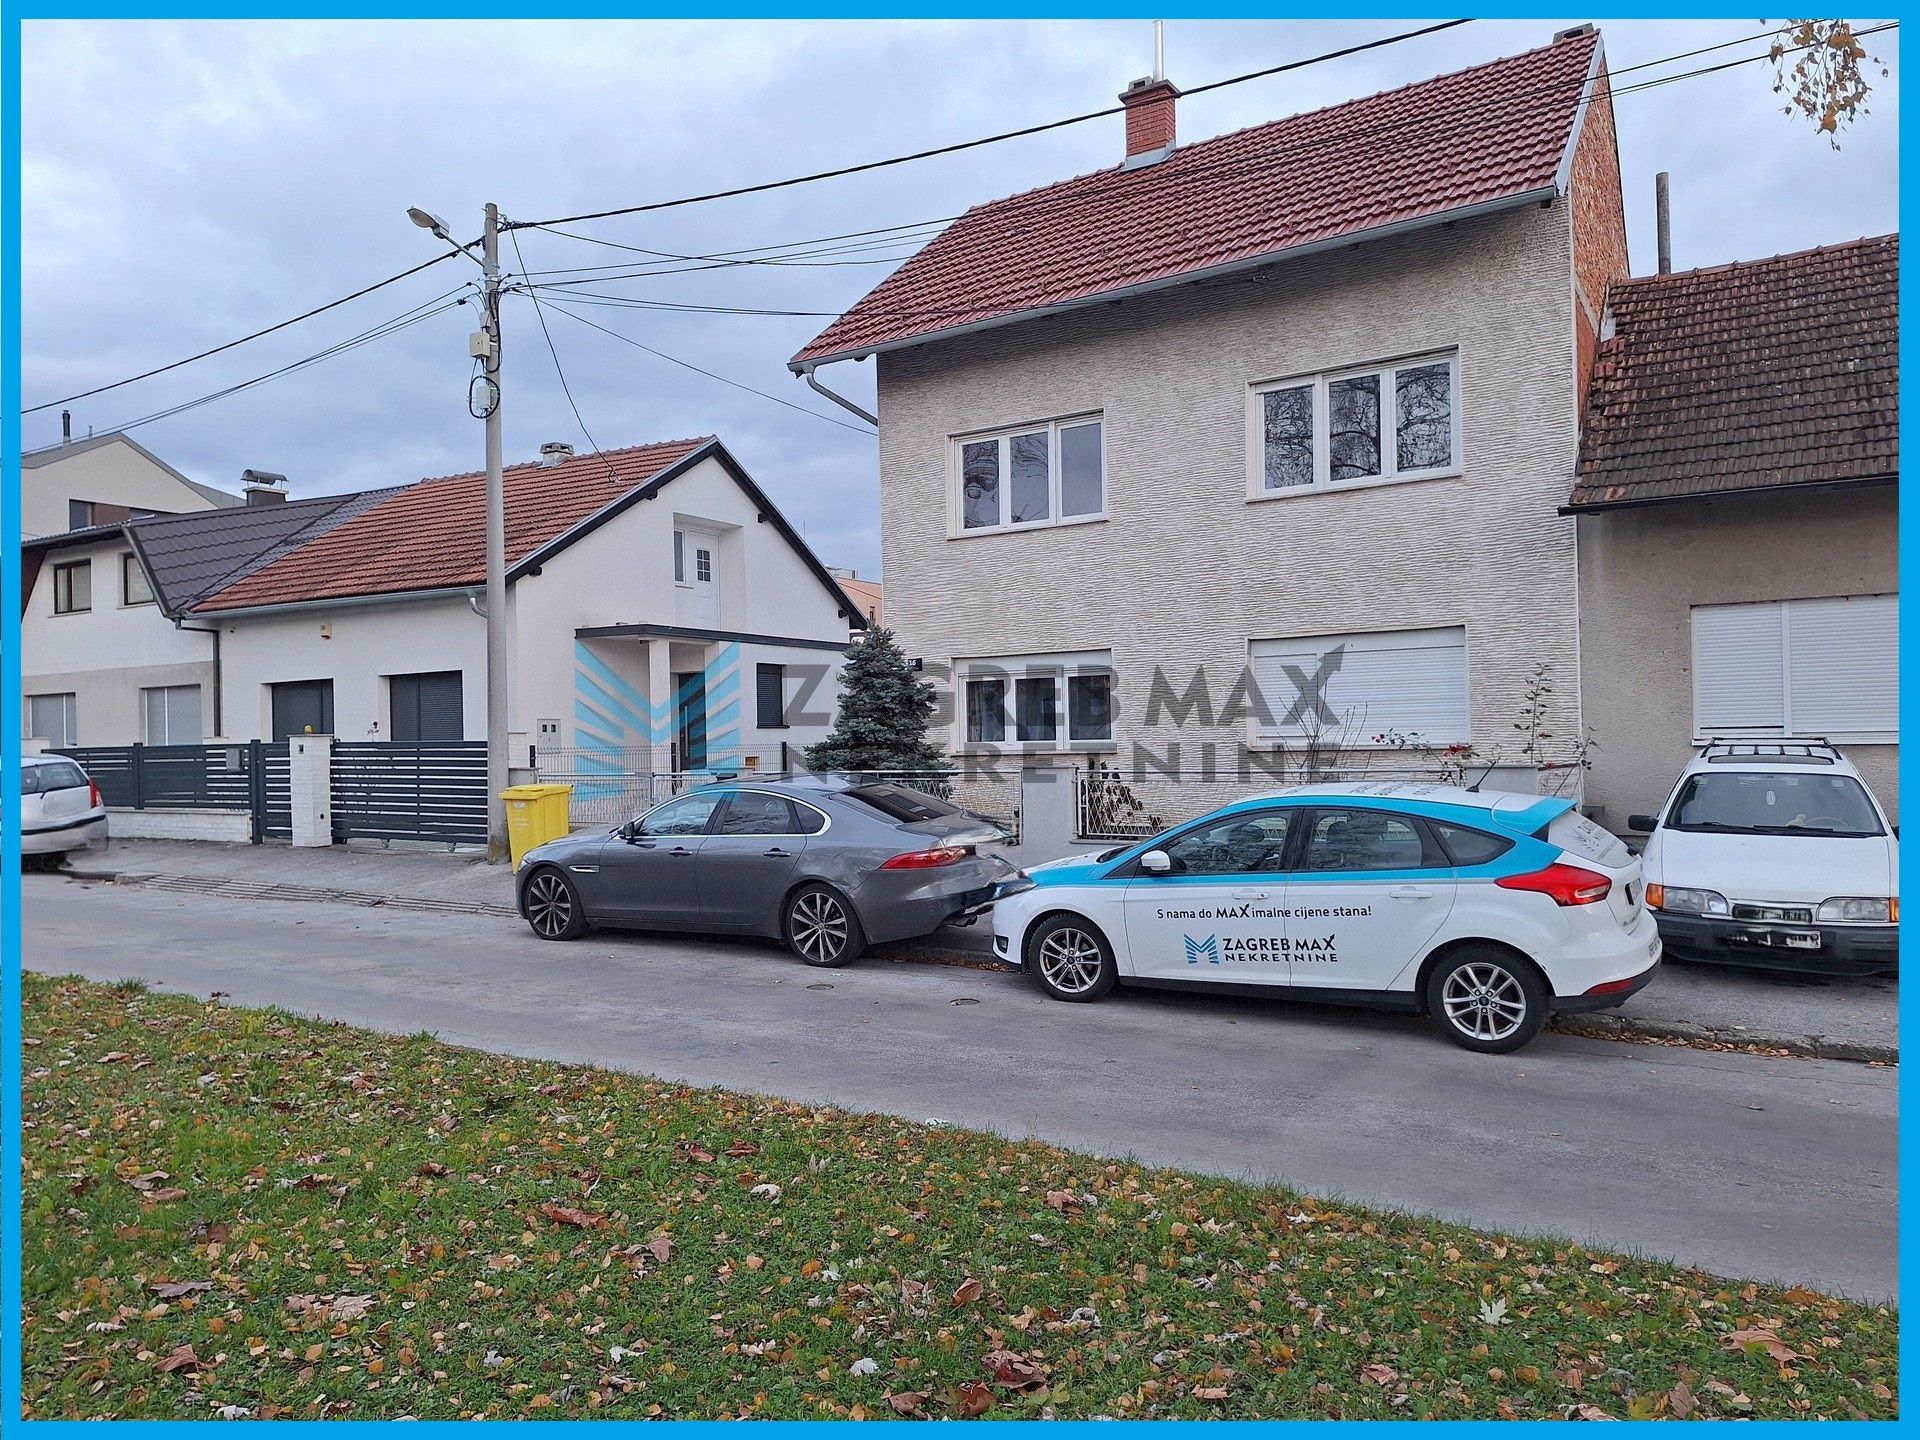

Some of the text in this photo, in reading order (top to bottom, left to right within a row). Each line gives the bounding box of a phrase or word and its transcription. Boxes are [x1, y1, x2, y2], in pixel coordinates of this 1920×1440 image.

[1157, 903, 1372, 920] S nama do MAX imalne cijene stana!
[1222, 933, 1336, 951] ZAGREB MAX
[1225, 953, 1338, 963] NEKRETNINE
